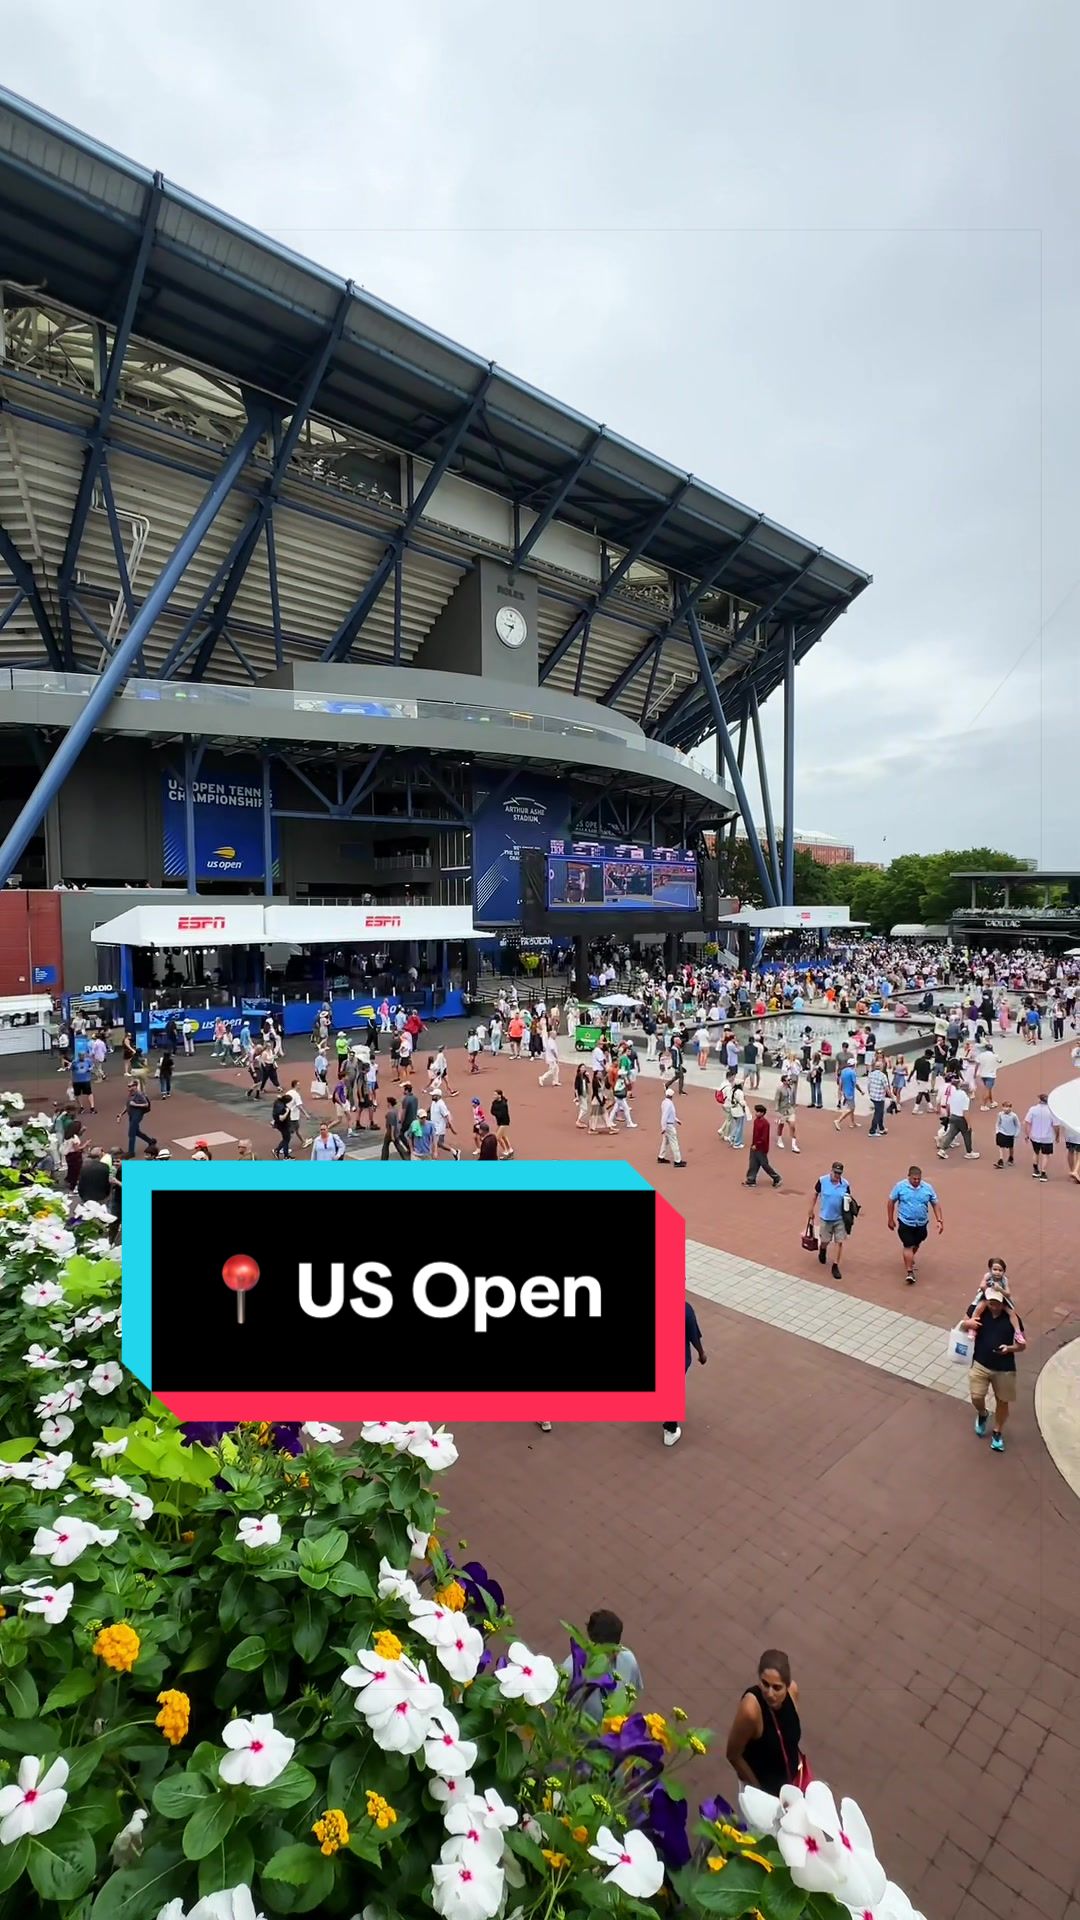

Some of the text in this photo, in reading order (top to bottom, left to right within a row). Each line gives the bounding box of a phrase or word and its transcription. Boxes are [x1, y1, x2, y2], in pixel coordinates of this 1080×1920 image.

[192, 782, 225, 794] OPEN
[504, 805, 545, 816] ARTHUR ASHE
[513, 814, 538, 823] STADIUM
[219, 862, 241, 870] open
[178, 917, 225, 929] ESPN
[365, 916, 400, 927] ESPN
